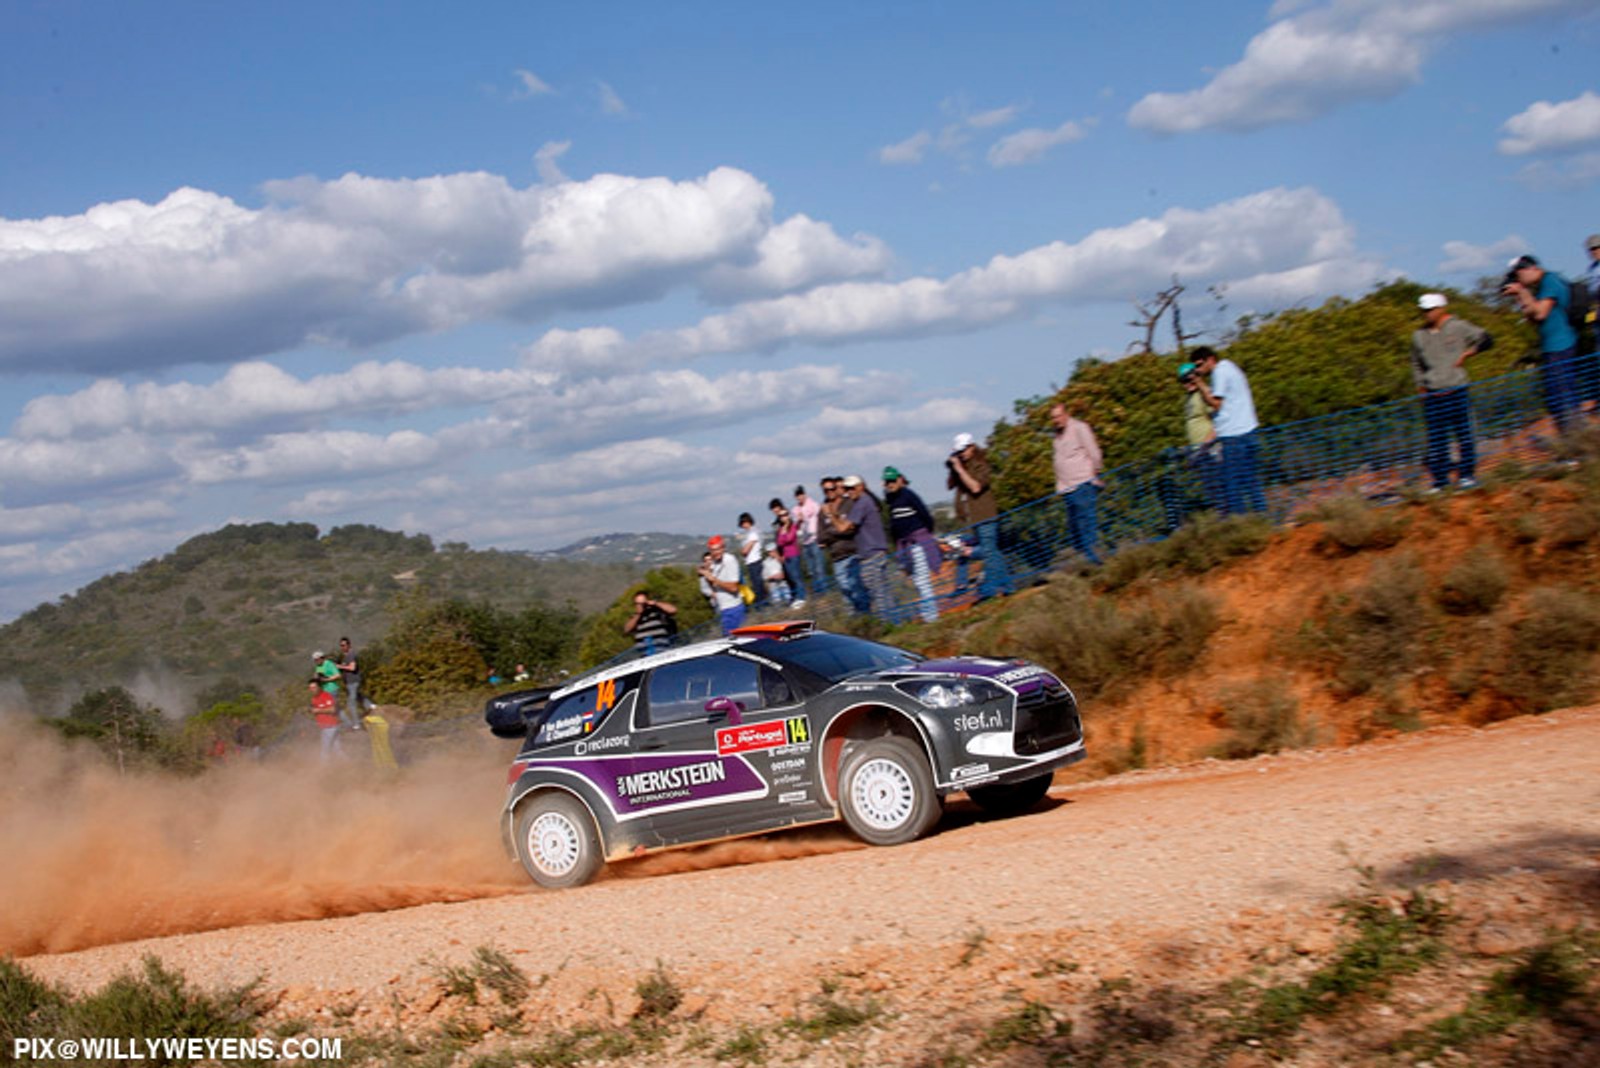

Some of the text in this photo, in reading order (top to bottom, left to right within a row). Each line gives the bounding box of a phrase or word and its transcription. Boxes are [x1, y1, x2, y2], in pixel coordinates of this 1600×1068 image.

[596, 678, 616, 711] 14
[788, 717, 807, 743] 14
[629, 789, 692, 804] INTERNATIONAL
